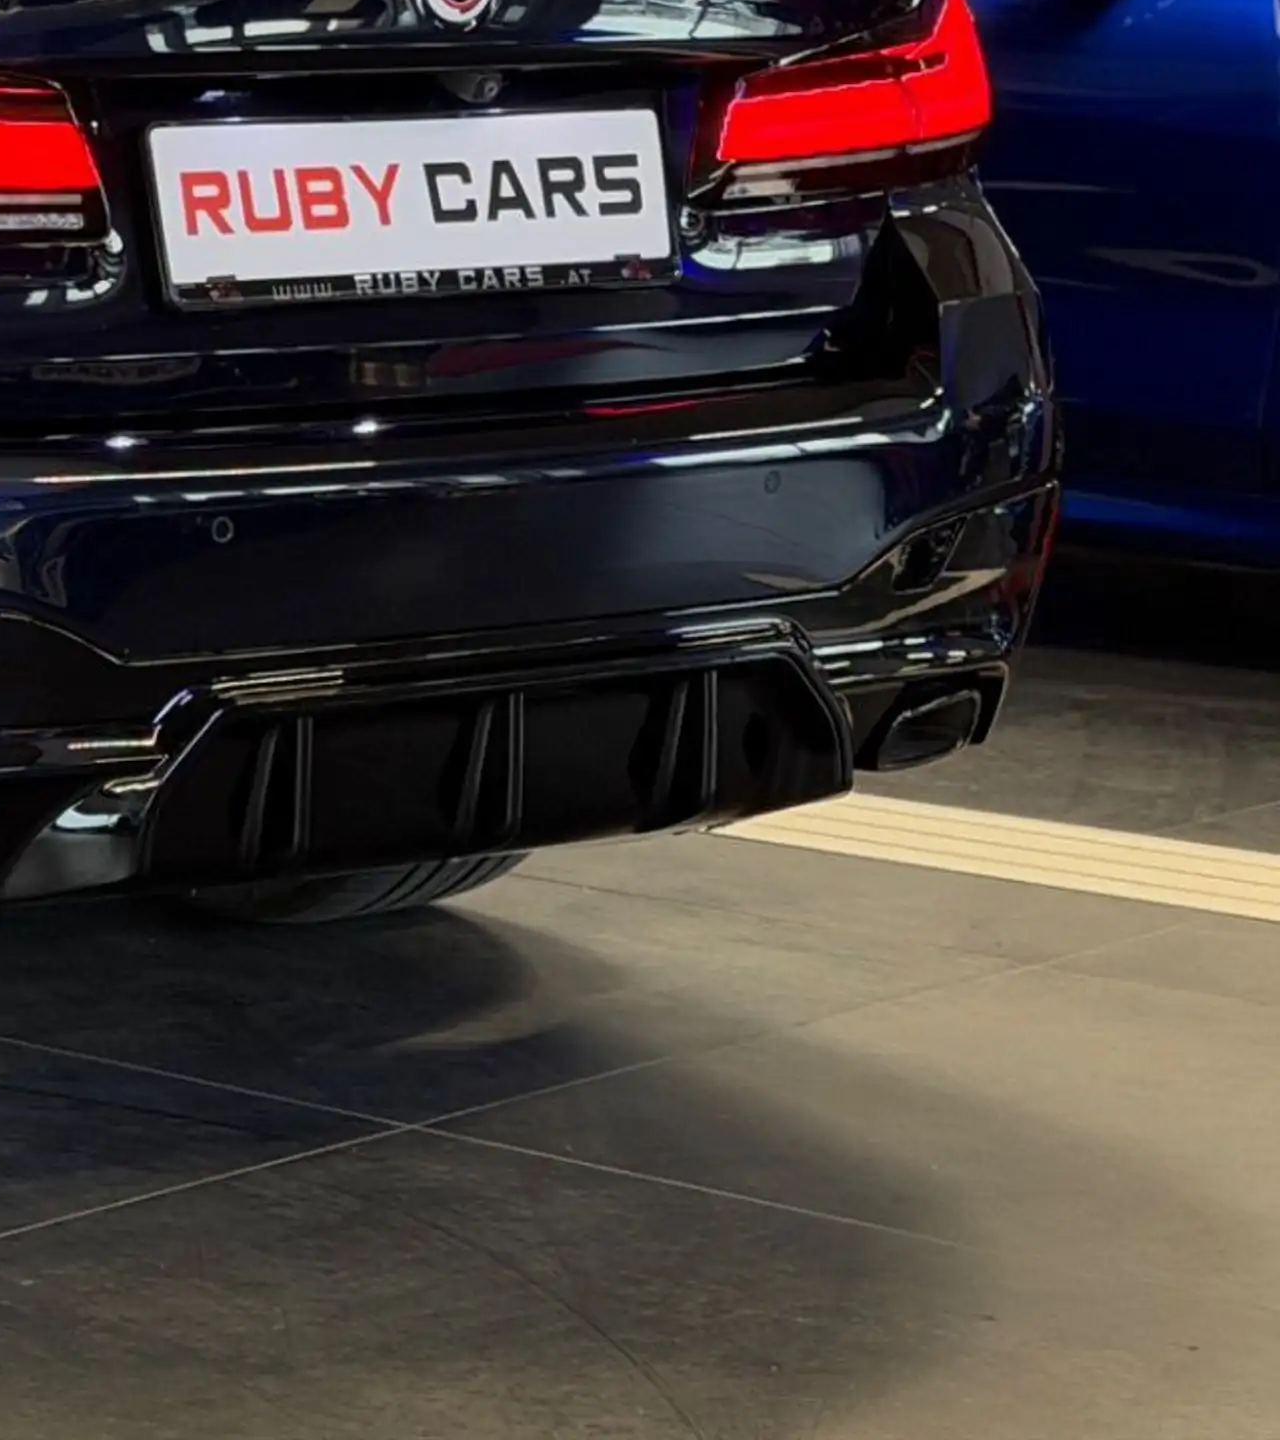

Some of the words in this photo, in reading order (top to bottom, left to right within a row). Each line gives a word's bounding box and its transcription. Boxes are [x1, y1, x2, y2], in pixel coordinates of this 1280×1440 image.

[179, 163, 401, 237] RUBY
[422, 154, 644, 224] CARS
[353, 270, 441, 296] RUBY
[457, 266, 545, 290] CARS
